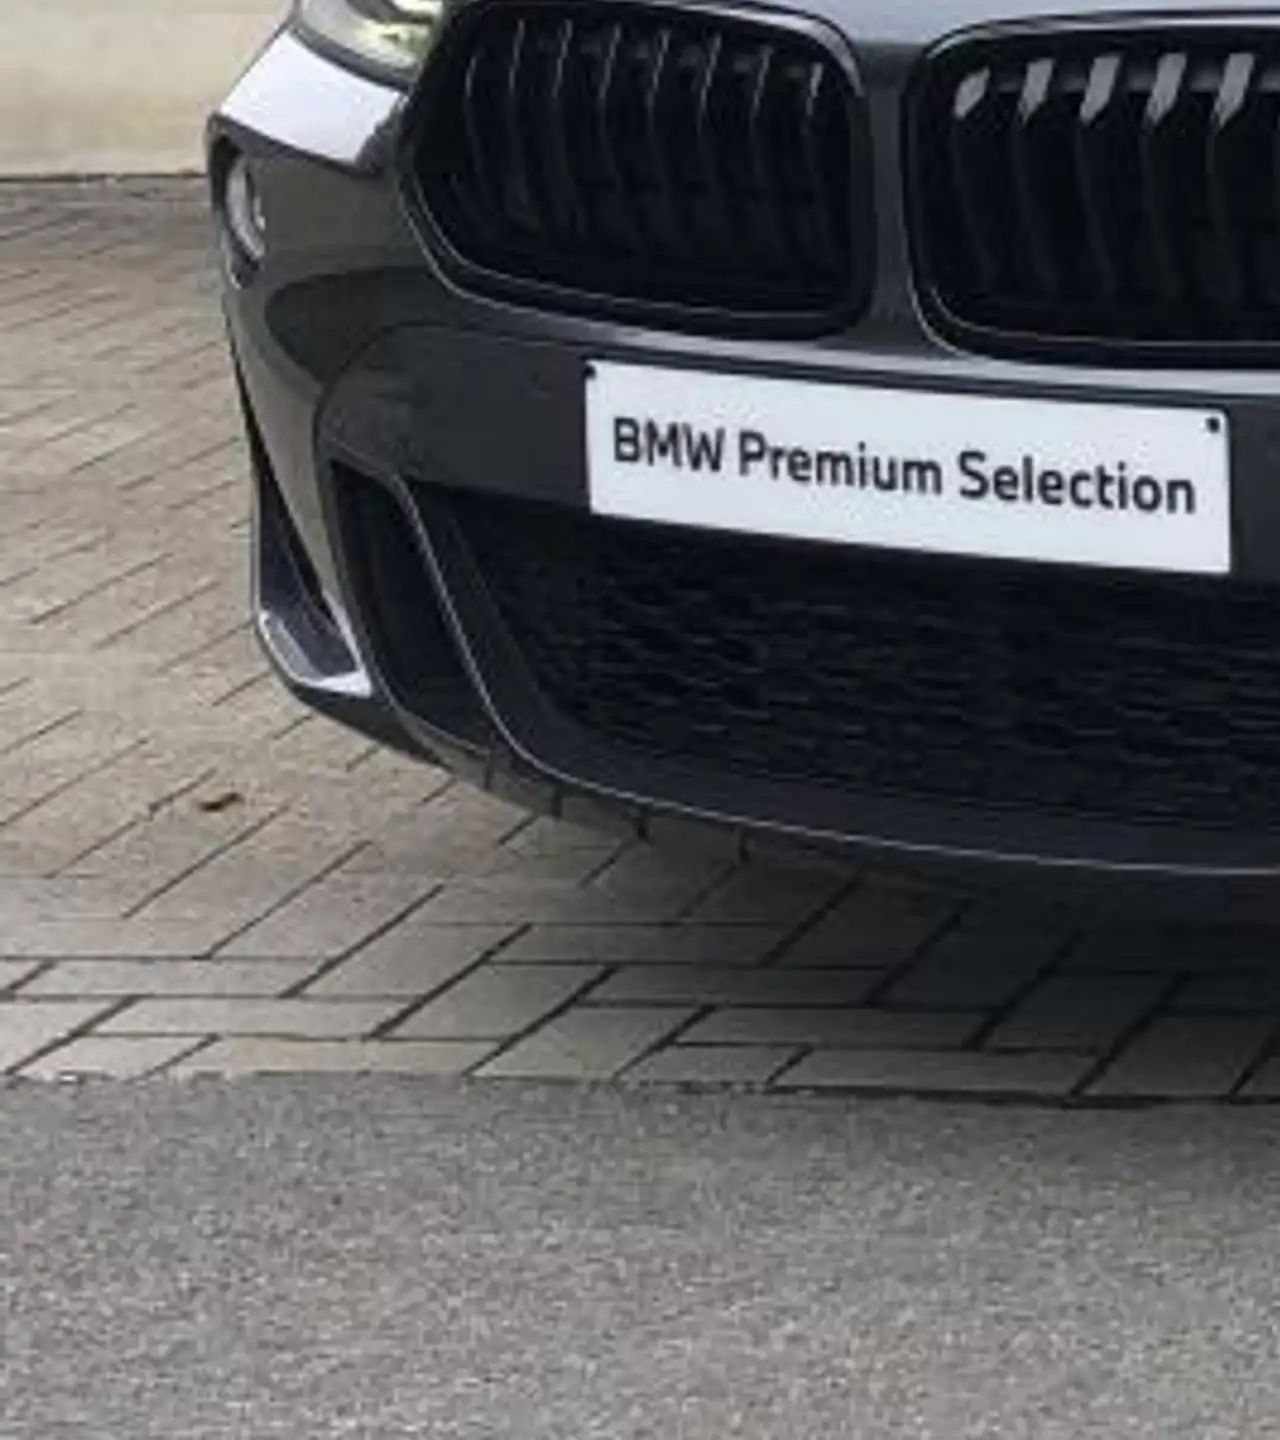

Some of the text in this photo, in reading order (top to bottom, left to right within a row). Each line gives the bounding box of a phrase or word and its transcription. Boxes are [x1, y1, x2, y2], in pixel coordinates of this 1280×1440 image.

[613, 417, 1196, 514] BMW Premium Selection
